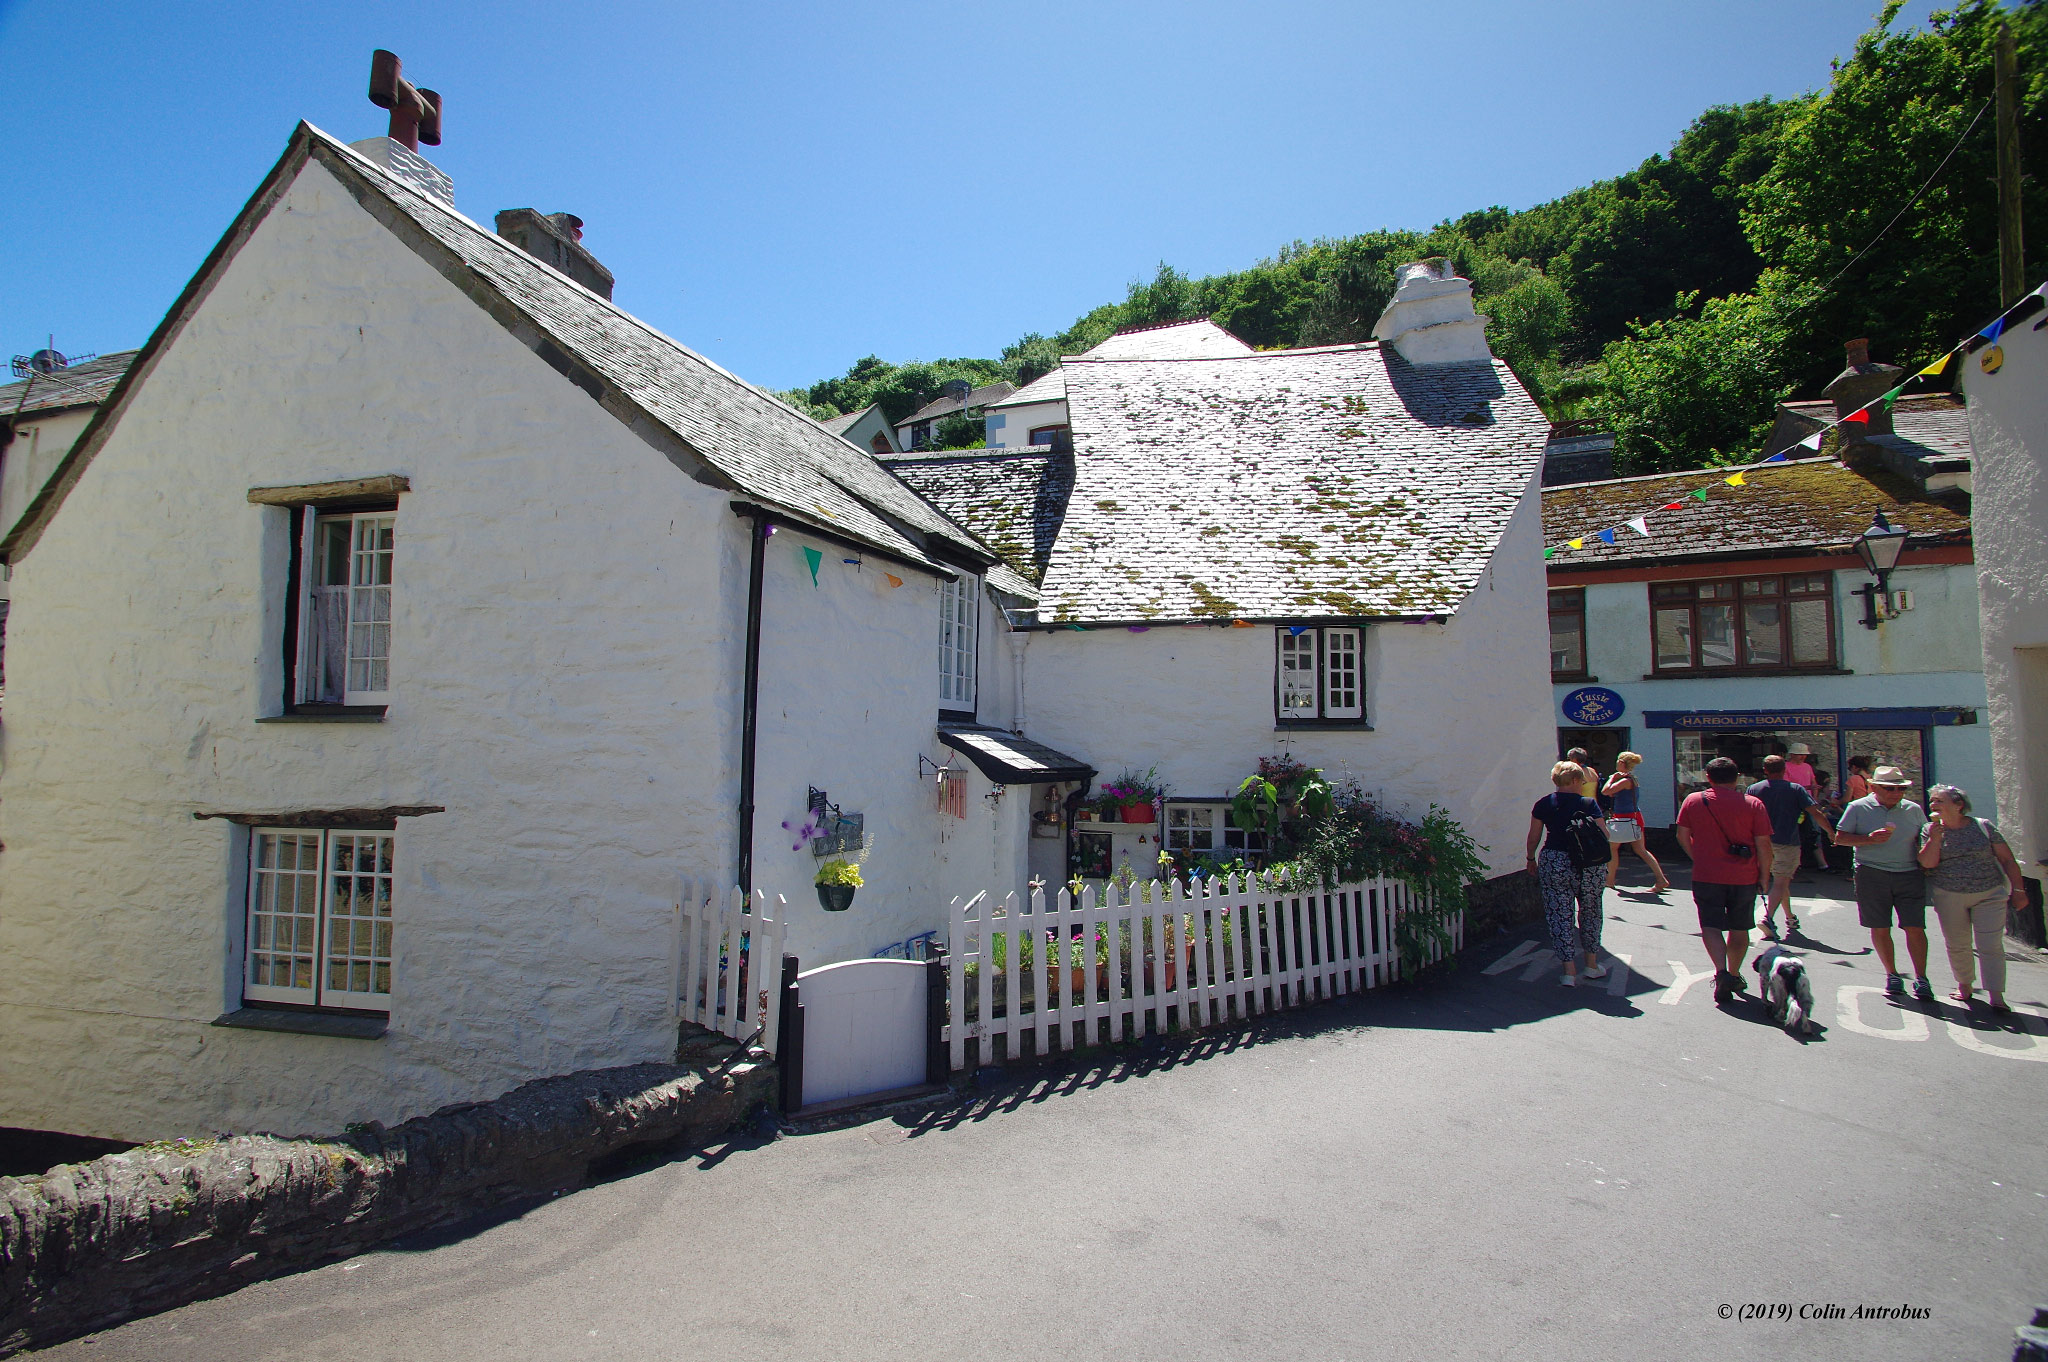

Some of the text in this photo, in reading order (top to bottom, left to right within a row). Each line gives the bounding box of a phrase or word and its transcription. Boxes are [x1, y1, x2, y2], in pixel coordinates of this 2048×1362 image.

[1575, 691, 1610, 703] Tussie
[1573, 709, 1614, 722] Mussie
[1683, 716, 1748, 725] HARBOUR
[1755, 715, 1791, 725] BOAT
[1792, 715, 1834, 725] TRIPS
